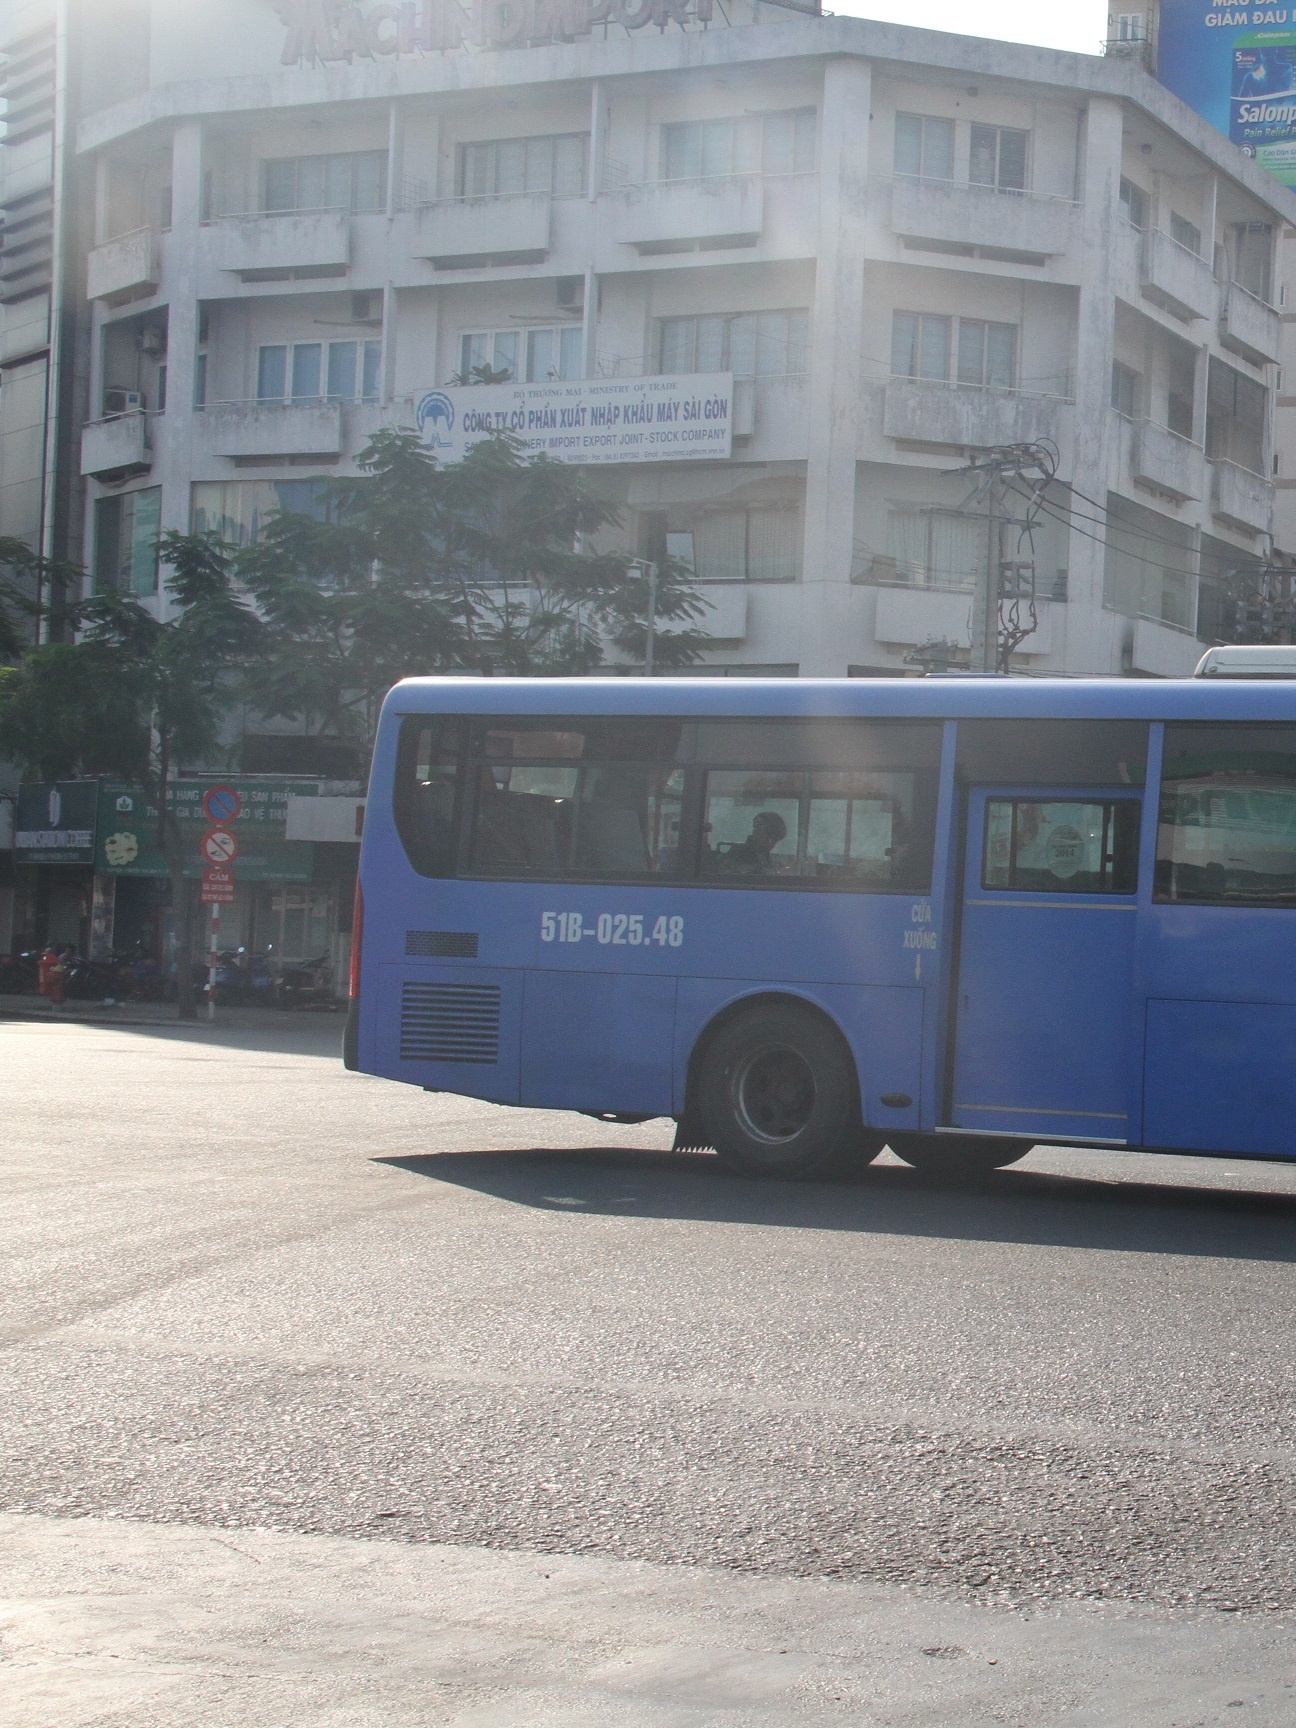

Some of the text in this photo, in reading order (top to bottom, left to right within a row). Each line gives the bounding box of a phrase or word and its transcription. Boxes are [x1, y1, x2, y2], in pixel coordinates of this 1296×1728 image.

[1204, 9, 1248, 27] GIẢM
[1252, 10, 1287, 25] ĐAU
[1244, 127, 1262, 138] Pain
[1265, 126, 1291, 137] Relief
[589, 384, 629, 395] MINISTRY
[634, 384, 645, 393] OF
[649, 382, 678, 392] TRADE
[511, 400, 526, 431] CỔ
[528, 401, 557, 430] PHẦN
[560, 400, 587, 427] XUẤT
[591, 403, 620, 430] NHẬP
[623, 393, 653, 425] KHẨU
[657, 397, 680, 423] MÁY
[683, 394, 701, 422] SÀI
[704, 393, 728, 420] GÒN
[549, 435, 580, 449] IMPORT
[583, 434, 617, 448] EXPORT
[681, 428, 727, 441] COMPANY
[541, 911, 684, 947] 51B-025.48
[903, 926, 937, 950] XUỐNG
